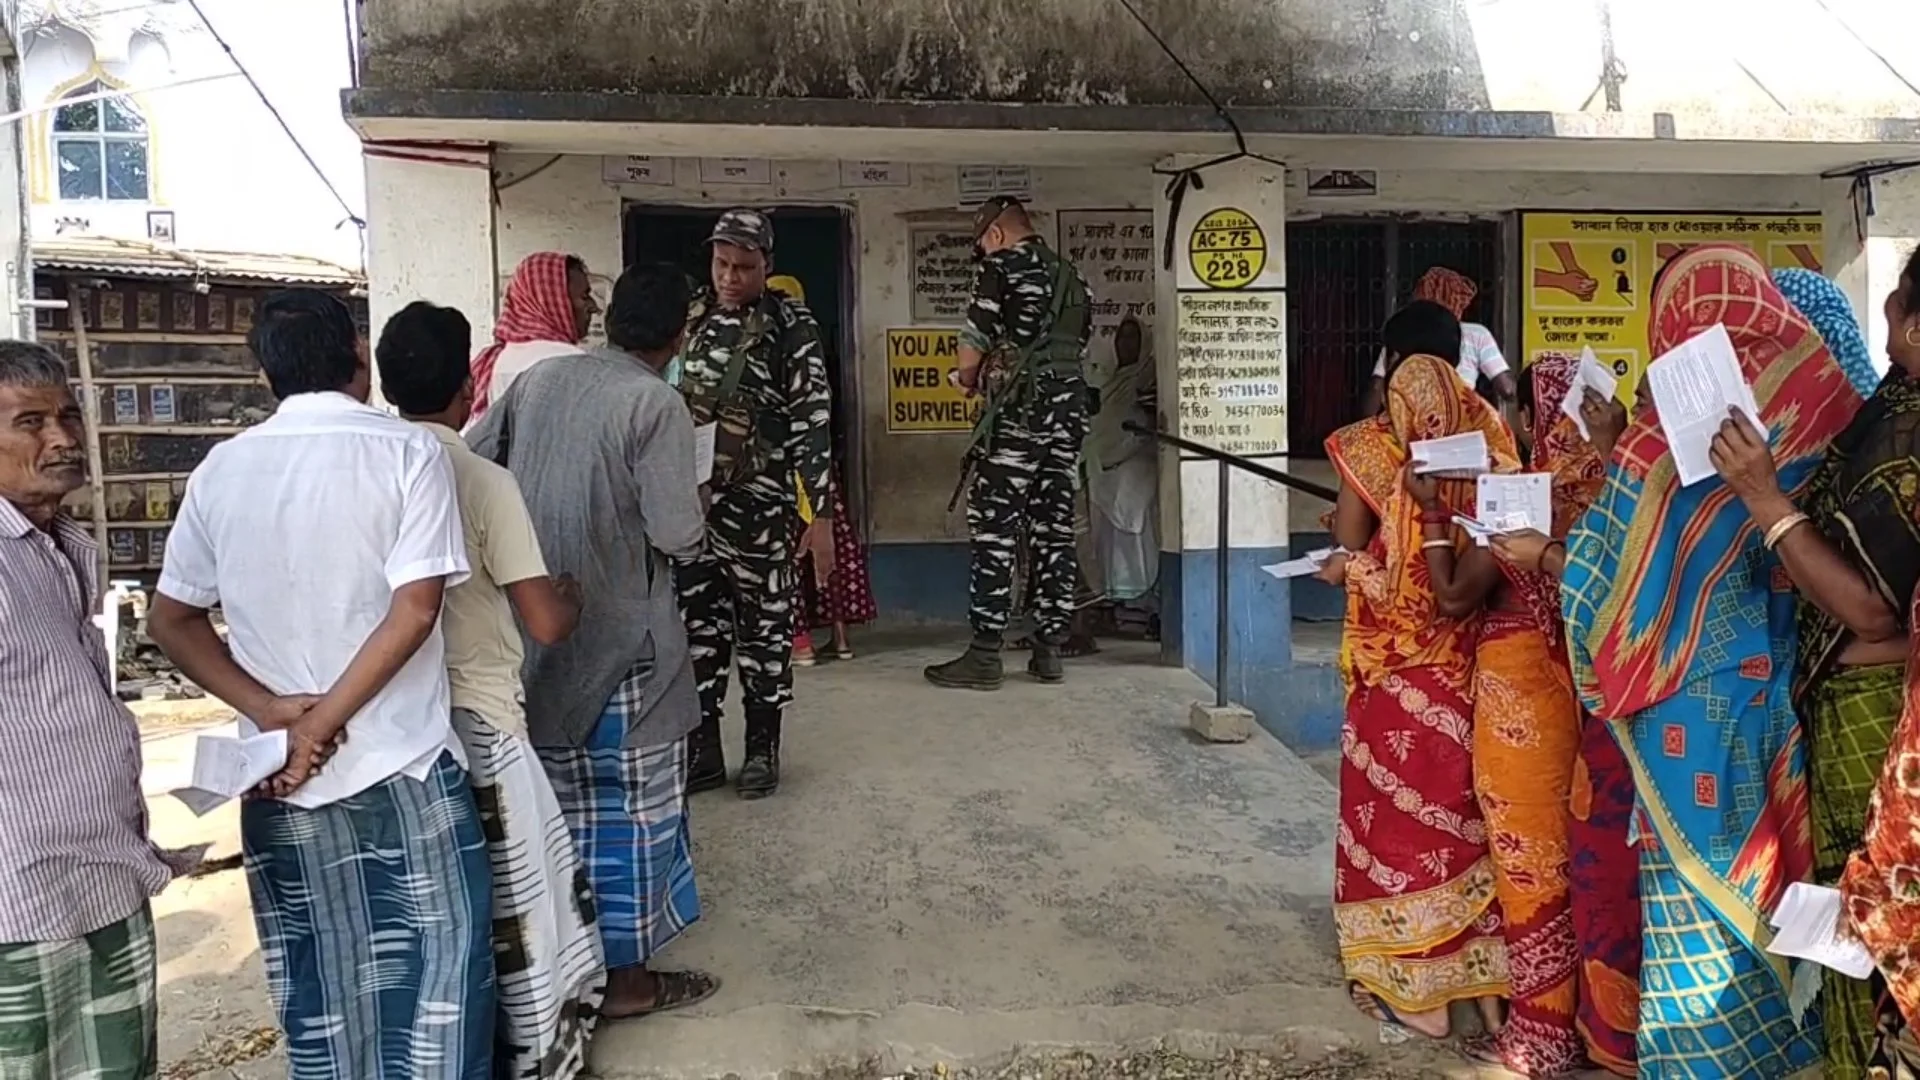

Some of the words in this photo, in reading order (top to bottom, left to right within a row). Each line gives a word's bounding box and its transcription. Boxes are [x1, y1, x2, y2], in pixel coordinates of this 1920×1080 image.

[1571, 219, 1611, 233] সাবান
[1615, 217, 1644, 234] দিয়ে
[1648, 220, 1669, 234] হাত
[1725, 217, 1761, 234] সঠিক
[1197, 231, 1251, 248] AC-75
[1207, 260, 1251, 281] 228
[891, 336, 928, 356] YOU
[935, 336, 958, 356] AR
[893, 368, 940, 388] WEB
